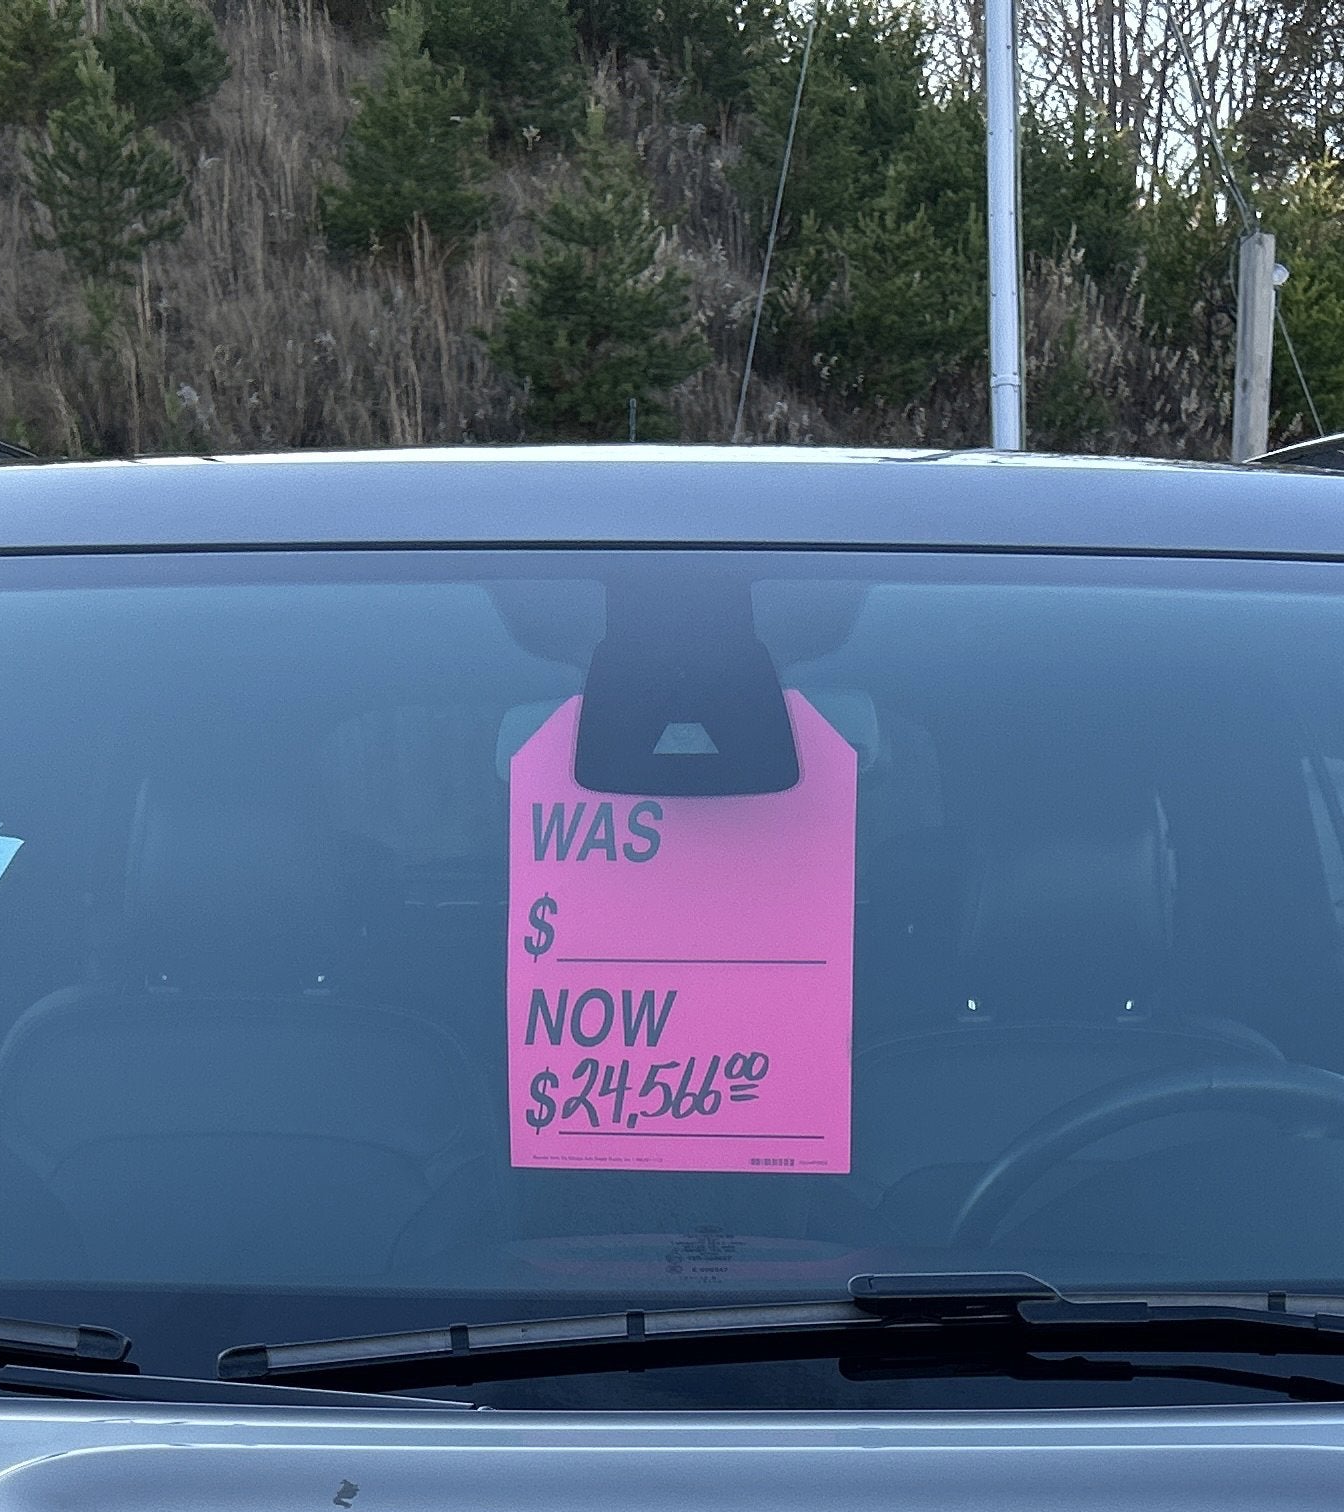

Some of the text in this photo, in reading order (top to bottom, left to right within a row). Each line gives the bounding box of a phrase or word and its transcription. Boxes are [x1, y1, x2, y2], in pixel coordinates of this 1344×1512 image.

[532, 800, 664, 863] WAS
[524, 892, 558, 963] $
[524, 988, 678, 1047] NOW
